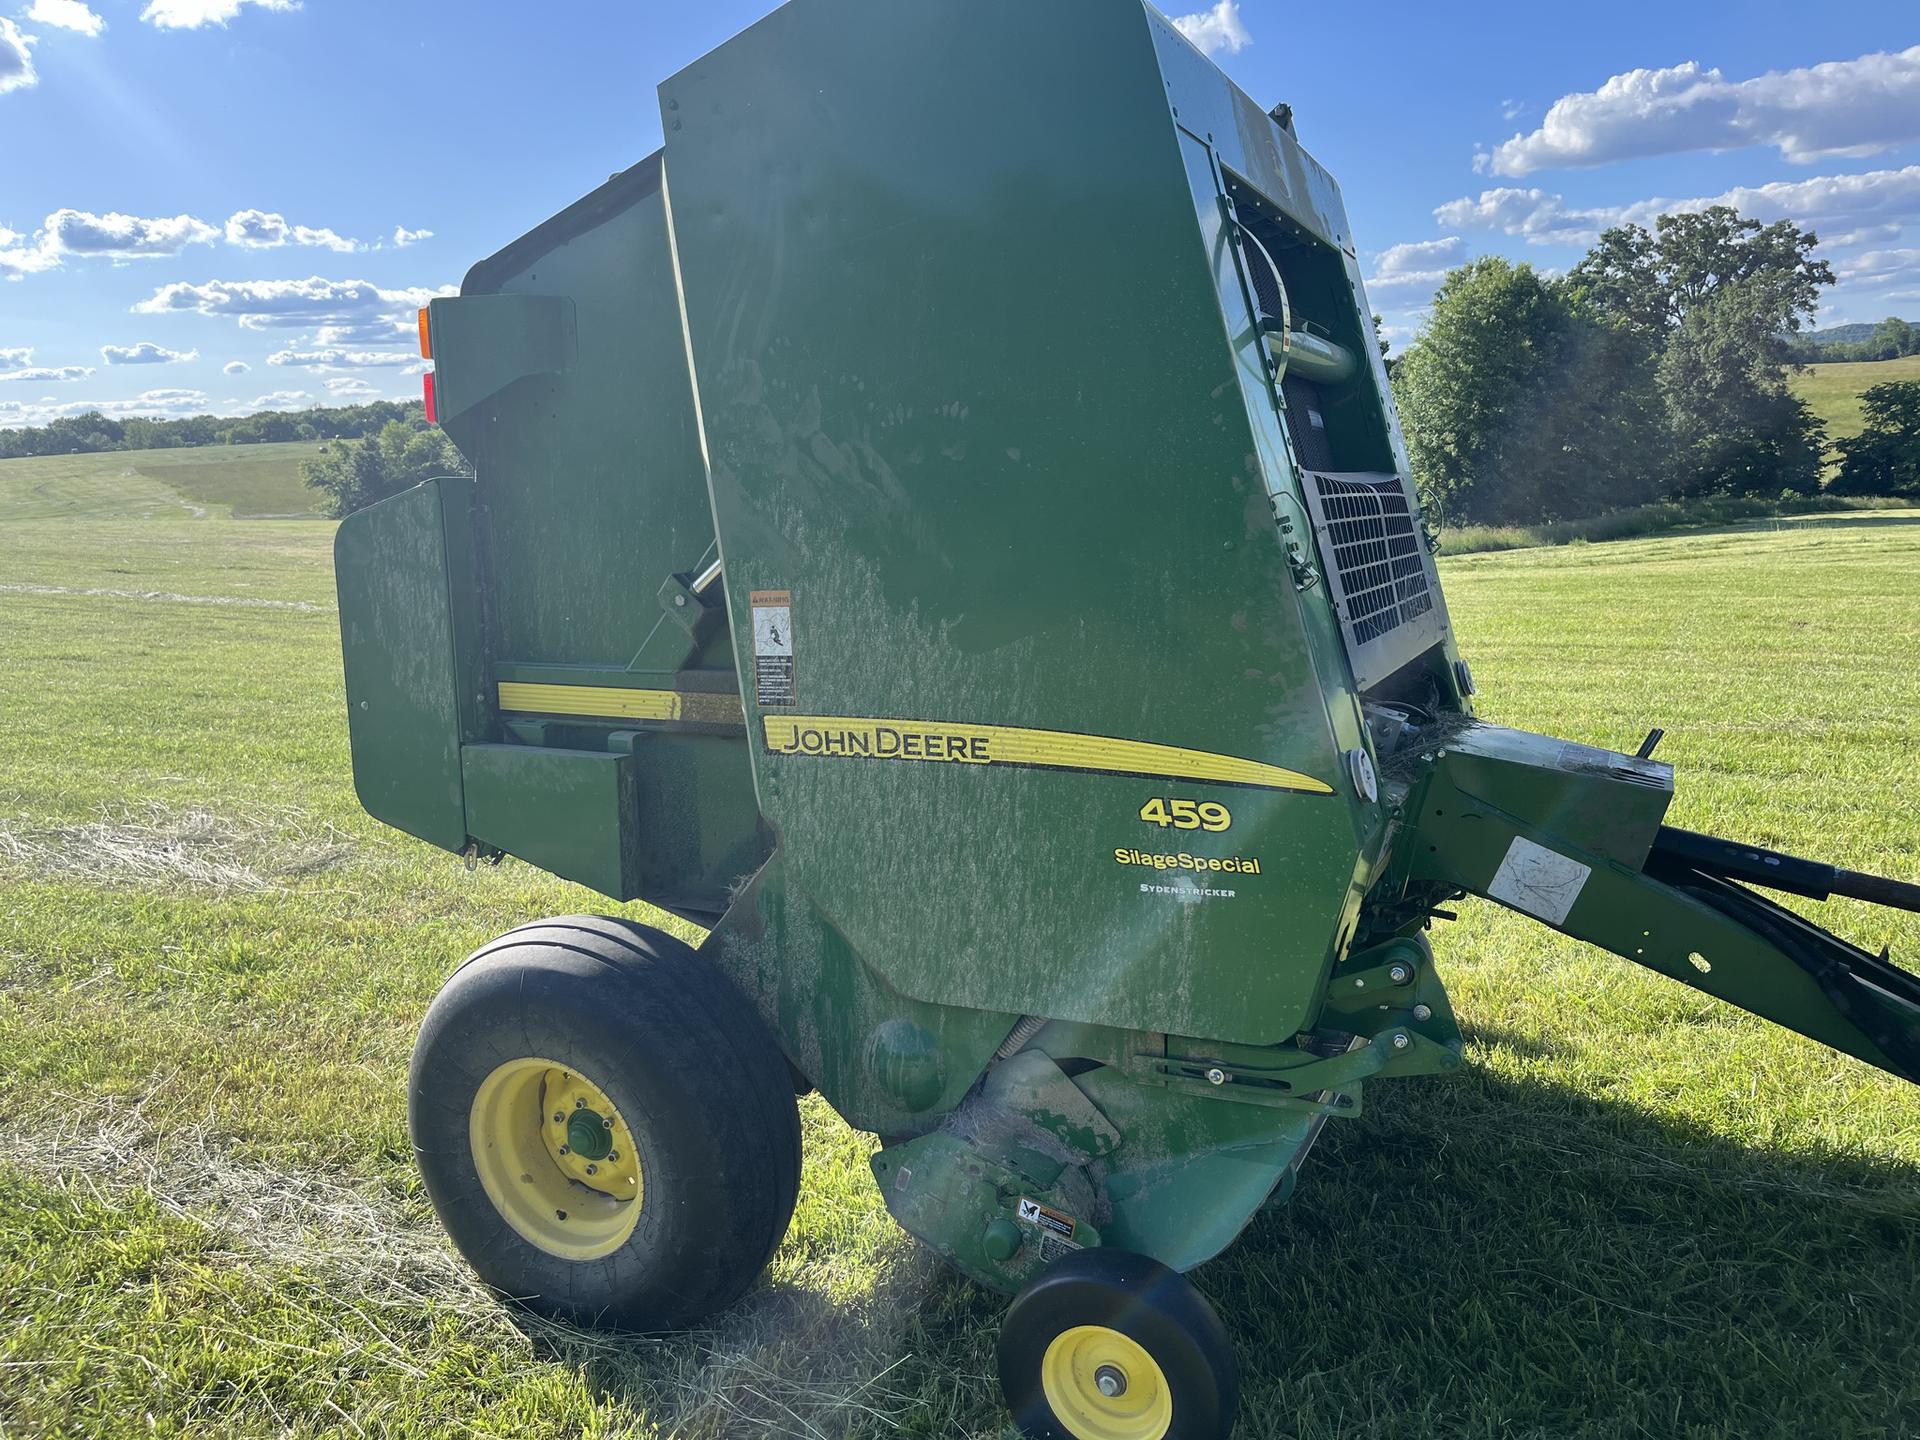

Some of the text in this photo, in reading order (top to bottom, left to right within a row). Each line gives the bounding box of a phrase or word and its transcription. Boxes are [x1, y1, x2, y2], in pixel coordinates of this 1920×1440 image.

[784, 725, 990, 760] JOHN DEERE
[1139, 797, 1232, 833] 459
[1114, 848, 1261, 874] SilageSpecial
[1140, 883, 1236, 898] SYDENSTRICKER
